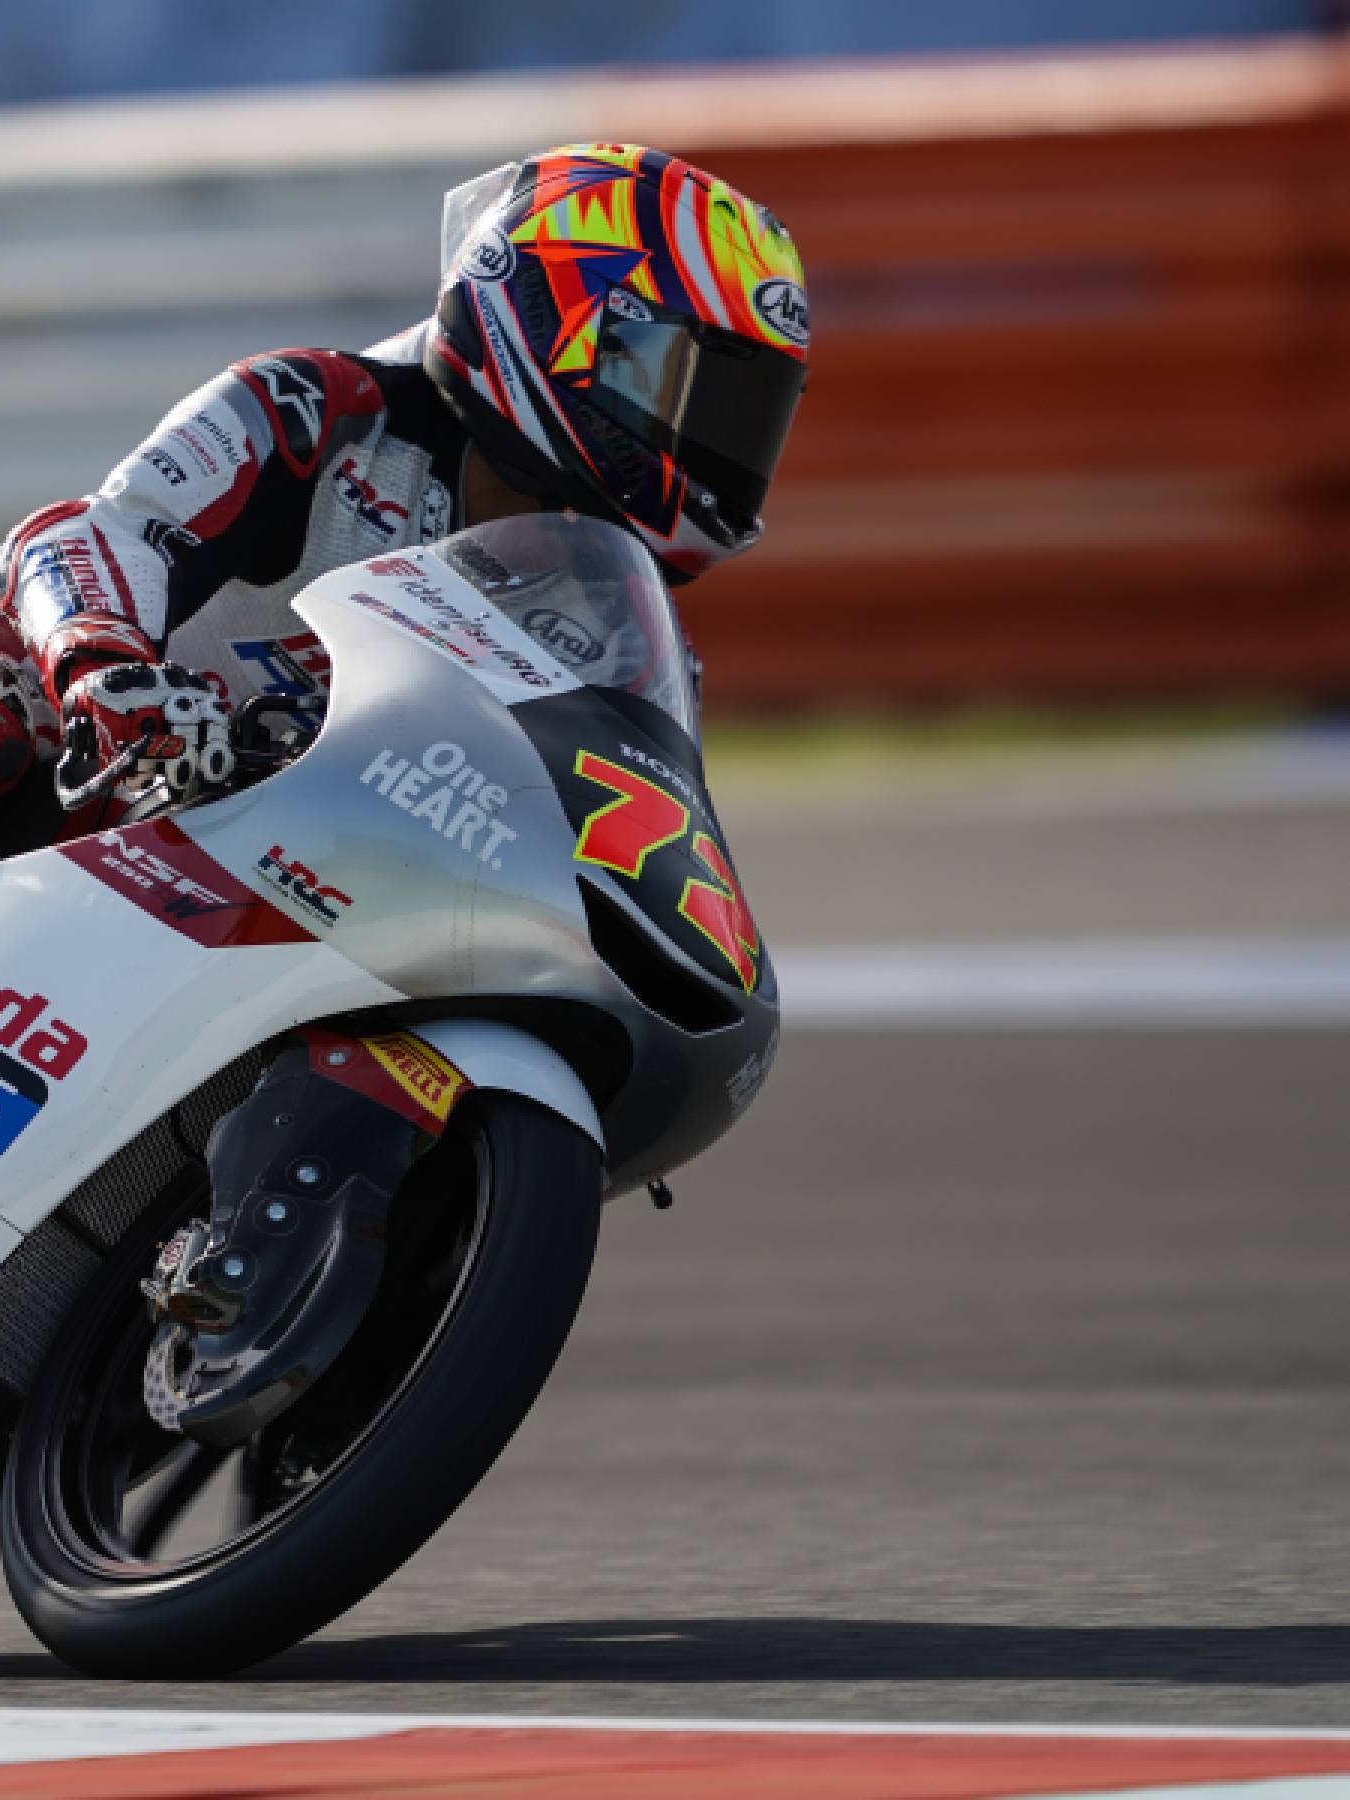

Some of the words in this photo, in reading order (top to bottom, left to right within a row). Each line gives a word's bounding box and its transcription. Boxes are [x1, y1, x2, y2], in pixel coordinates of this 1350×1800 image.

[359, 748, 518, 871] HEART.
[421, 740, 509, 811] One
[98, 830, 230, 904] NSF
[258, 844, 354, 920] HRC
